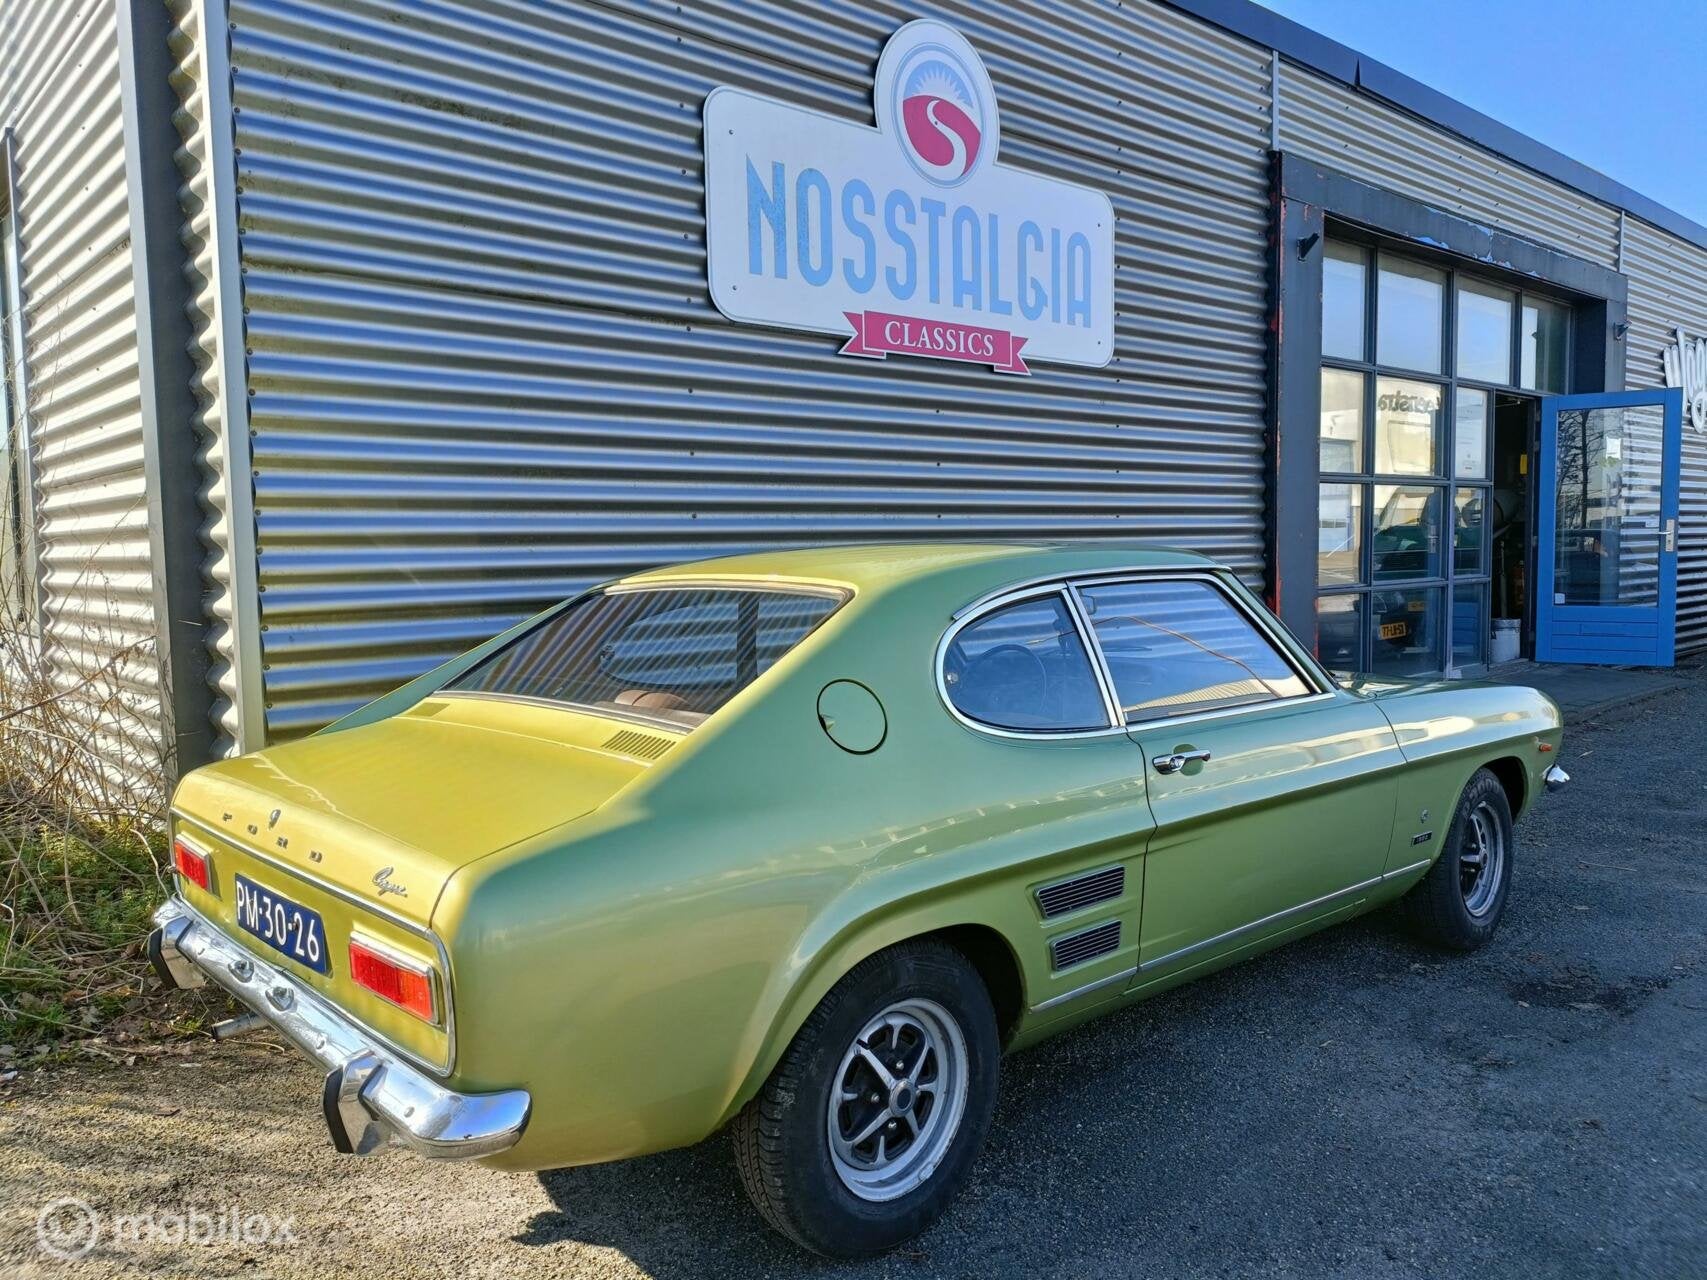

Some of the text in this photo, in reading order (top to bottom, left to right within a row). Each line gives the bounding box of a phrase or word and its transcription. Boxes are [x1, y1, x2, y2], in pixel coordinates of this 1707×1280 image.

[746, 154, 1091, 329] NOSSTALGIA
[885, 321, 993, 356] CLASSICS
[223, 812, 322, 863] FORD
[235, 881, 320, 963] PM-30-26
